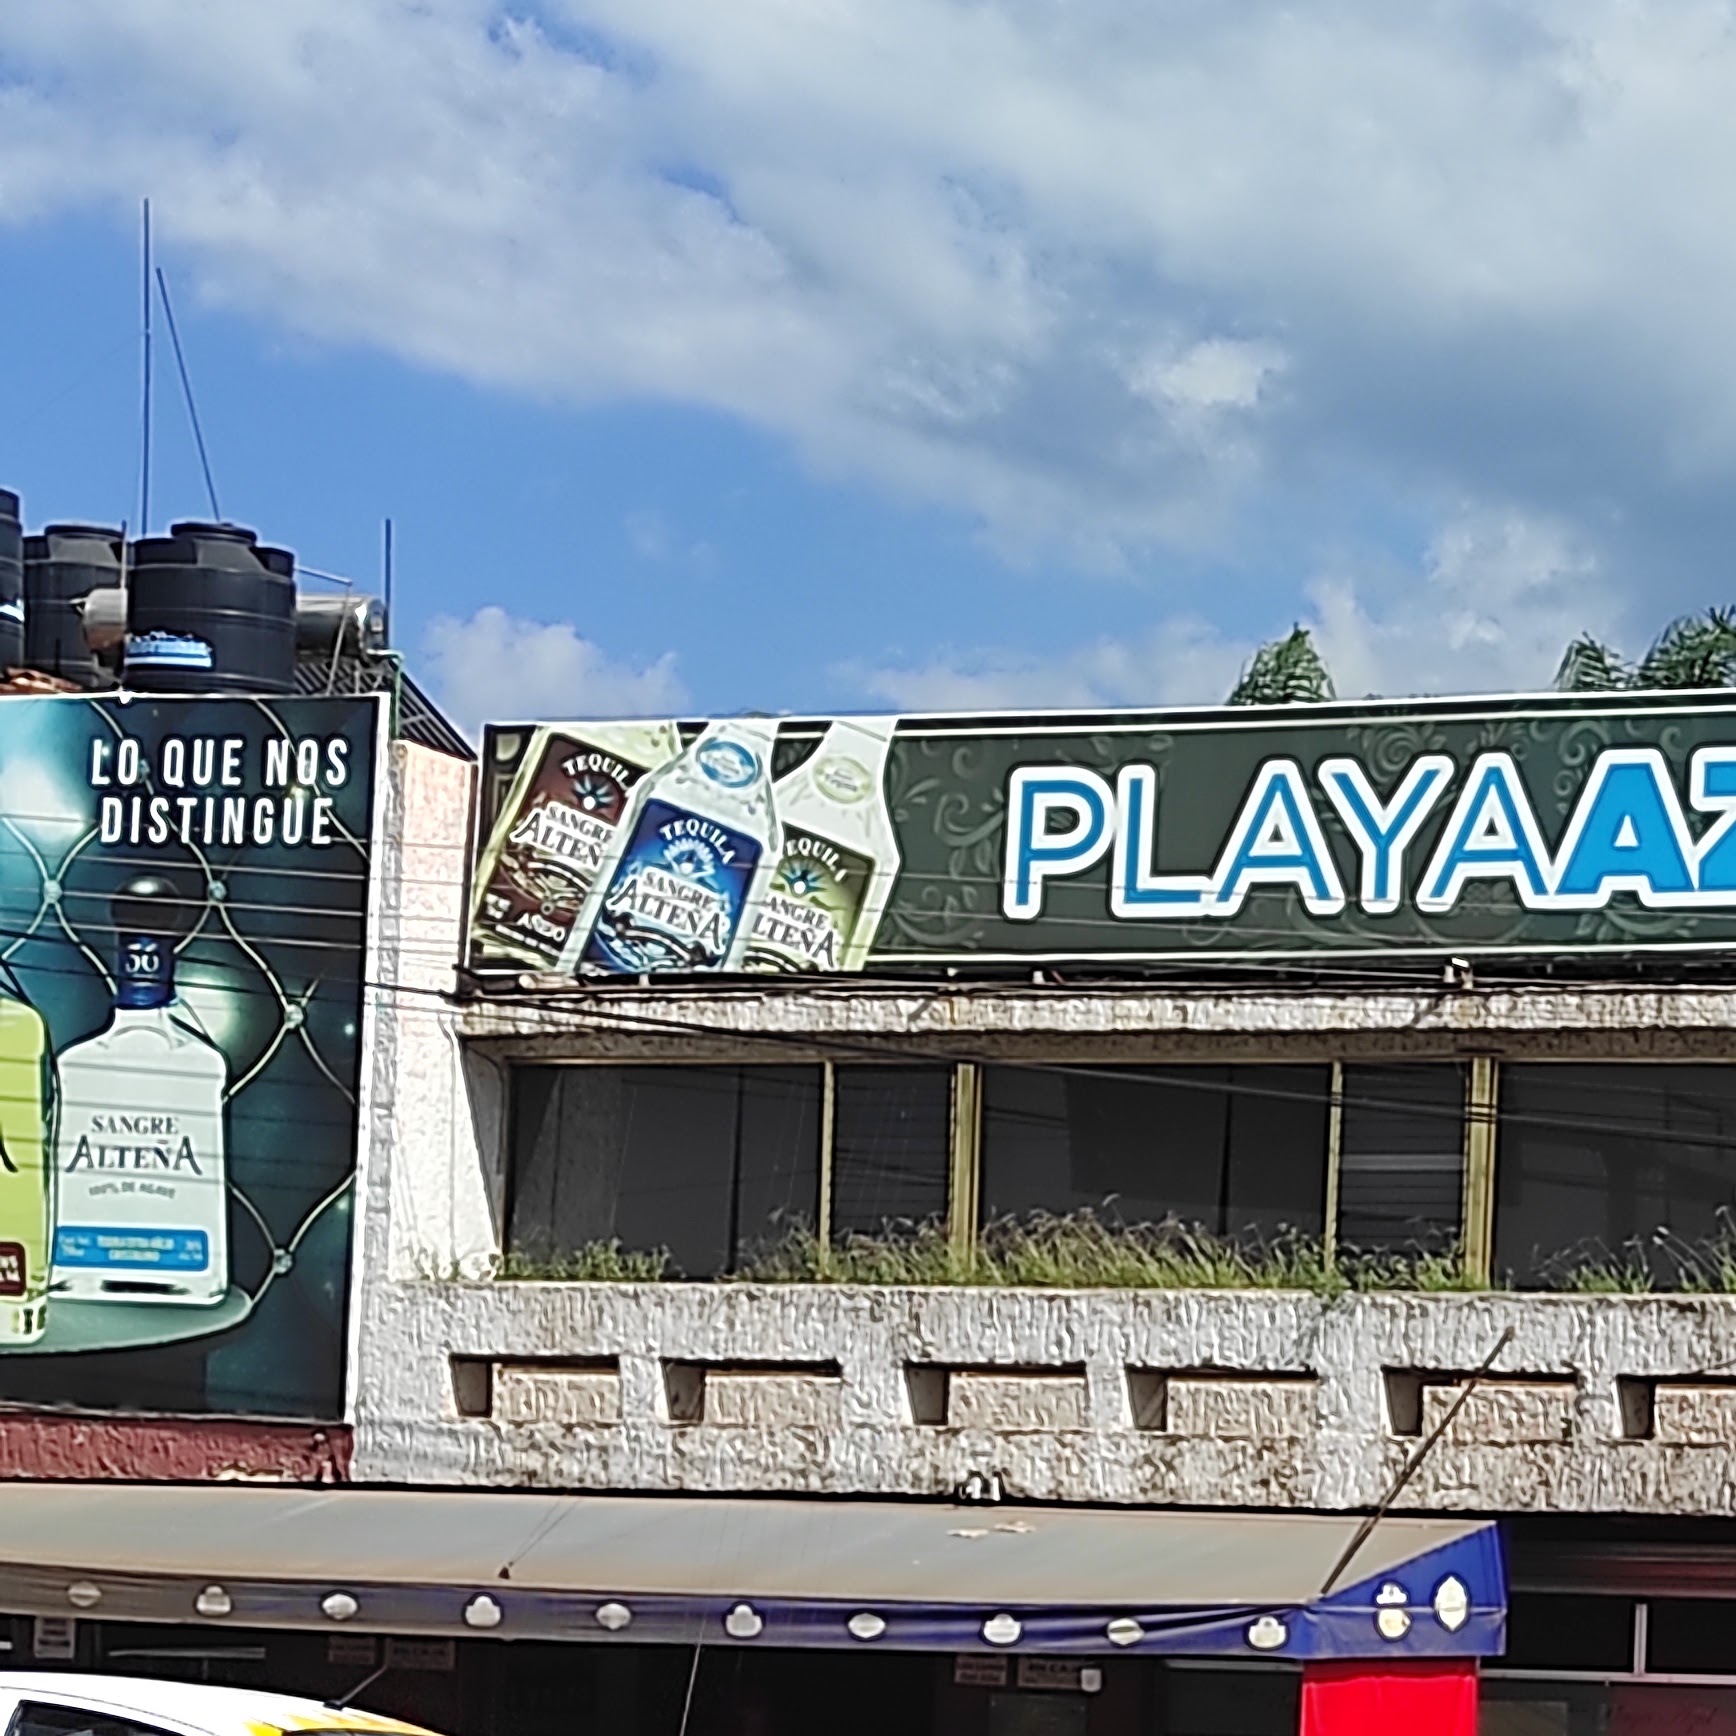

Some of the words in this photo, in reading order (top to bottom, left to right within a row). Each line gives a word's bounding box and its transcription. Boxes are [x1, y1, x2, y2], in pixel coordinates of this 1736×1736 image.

[91, 738, 140, 786] LO
[163, 738, 244, 788] QUE
[265, 737, 348, 787] NOS
[561, 752, 631, 798] TEQUIL
[100, 796, 334, 845] DISTINGUE
[659, 817, 736, 865] TEQUILA
[785, 836, 848, 883] EQUILA
[763, 895, 829, 931] ANGRE
[750, 911, 836, 968] LTEÑA
[91, 1114, 180, 1136] SANGRE
[64, 1133, 203, 1176] ALTEÑA
